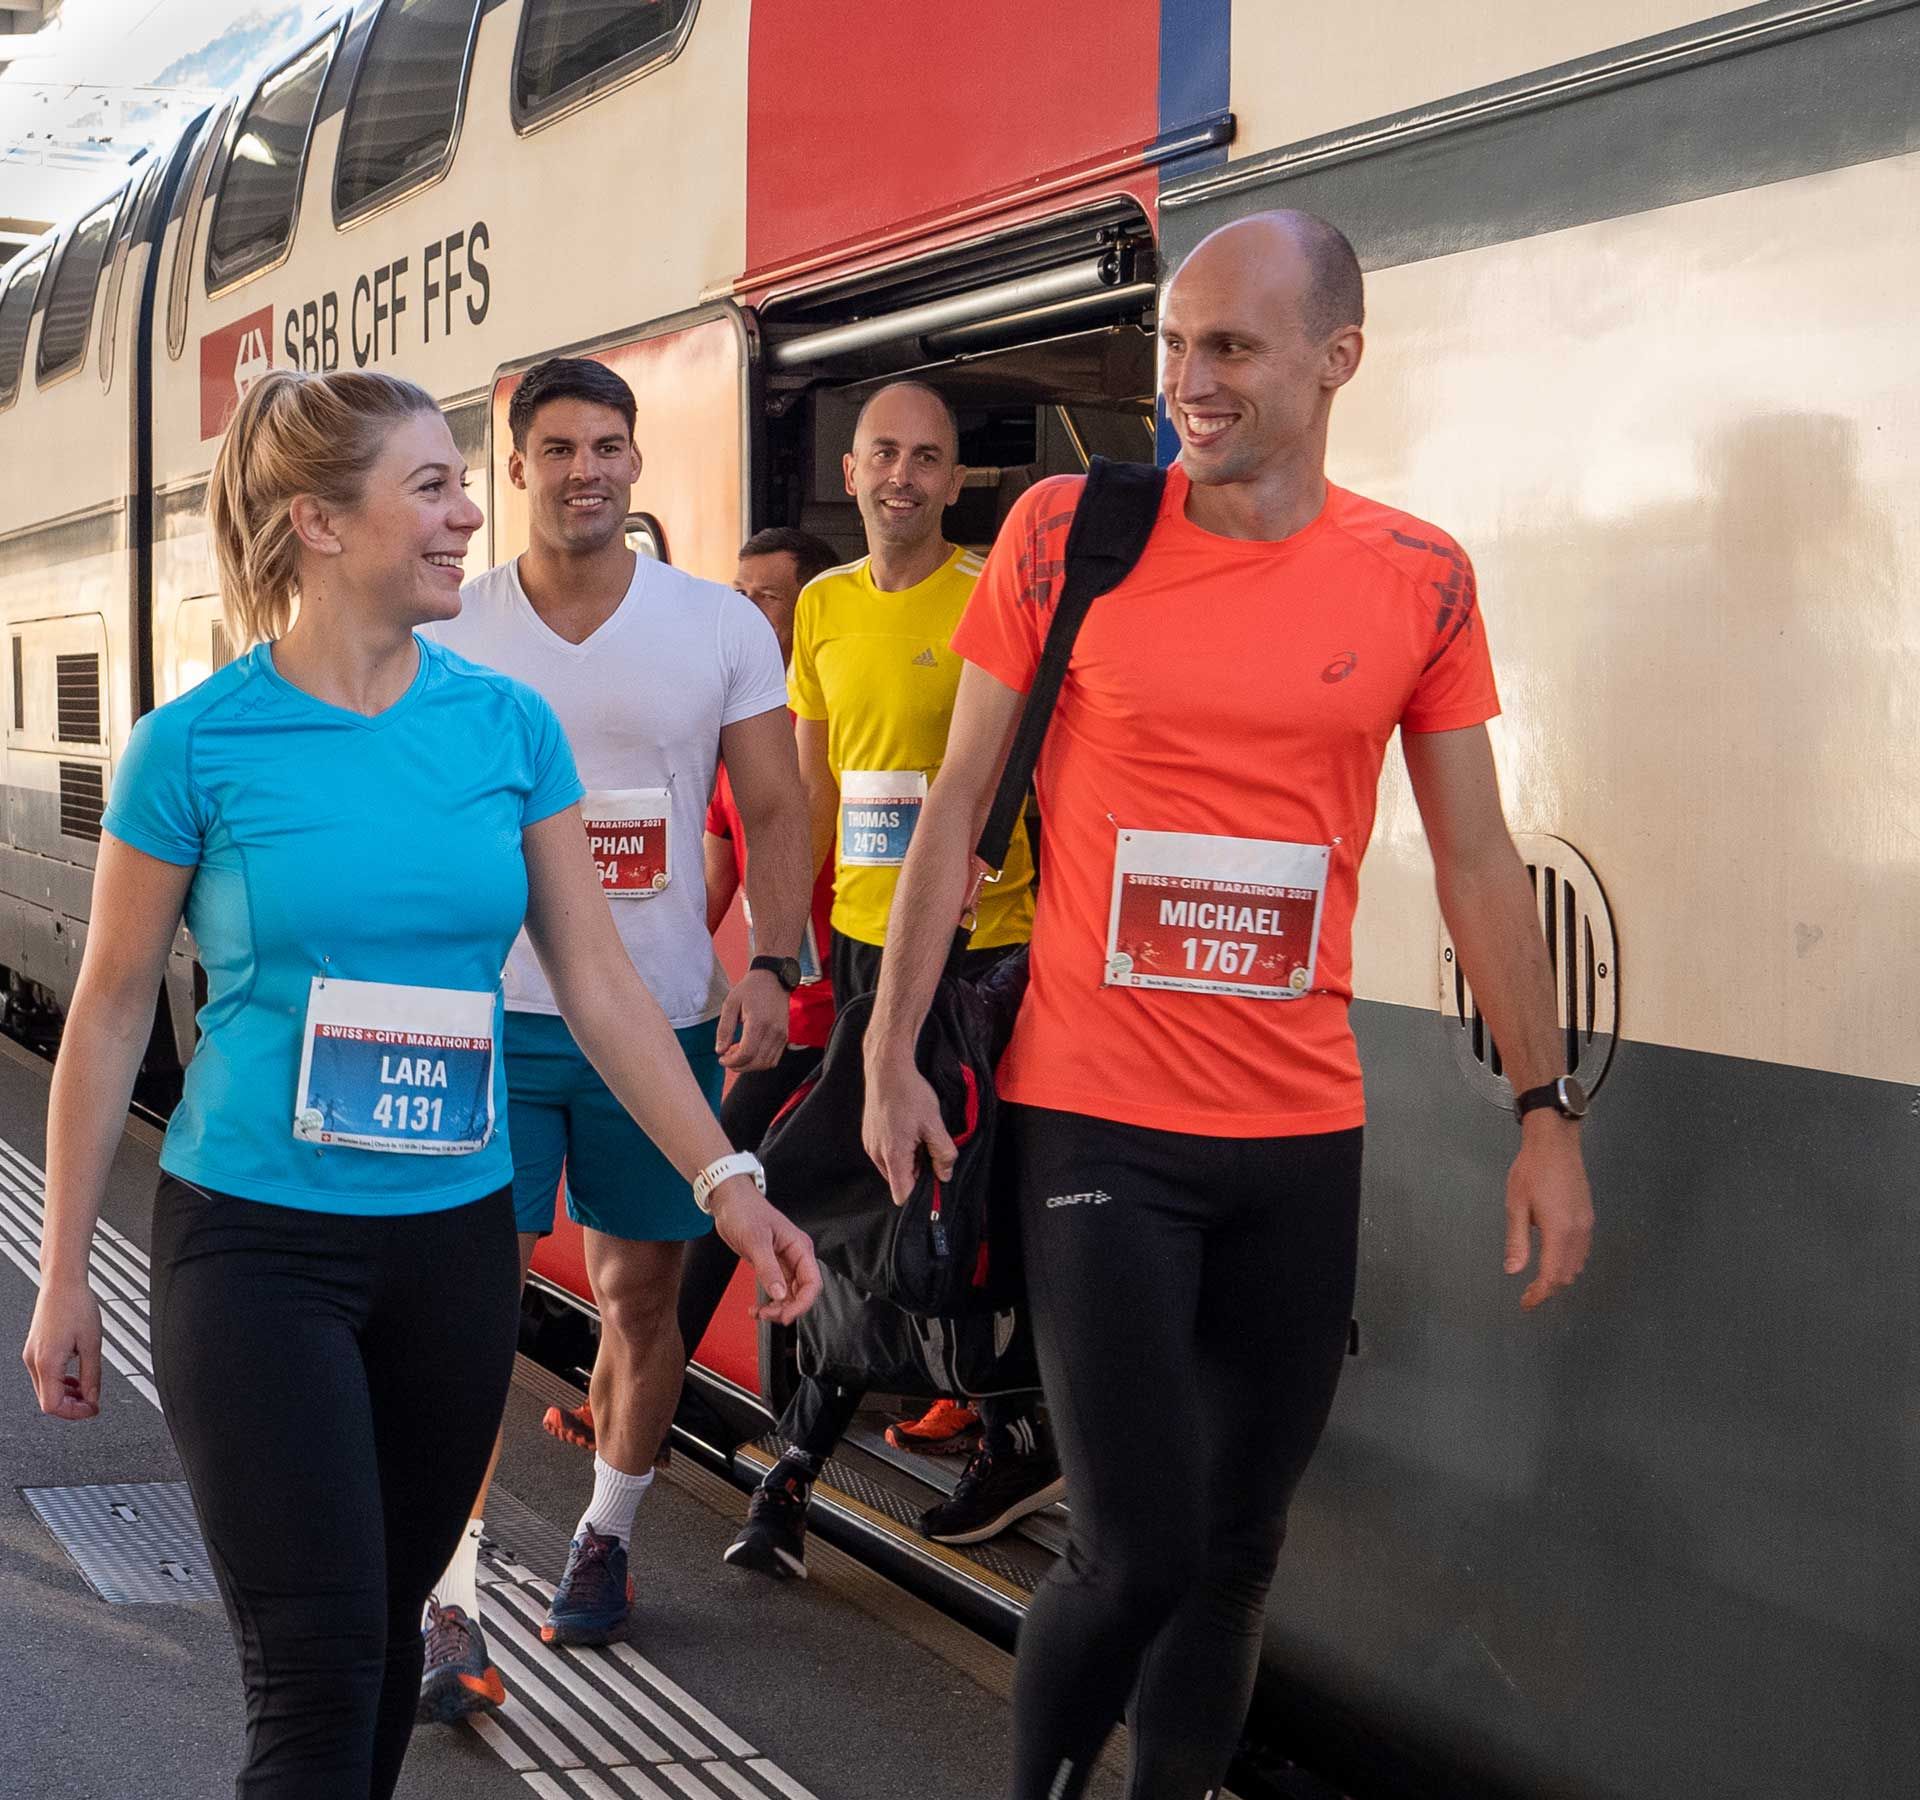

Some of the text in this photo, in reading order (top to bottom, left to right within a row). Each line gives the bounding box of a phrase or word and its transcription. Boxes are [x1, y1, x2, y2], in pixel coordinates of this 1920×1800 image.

[285, 221, 490, 374] SBB CFF FFS
[591, 821, 641, 829] MARATHON
[643, 820, 662, 828] 2021
[848, 812, 900, 828] THOMAS
[587, 836, 644, 855] PHAN
[854, 832, 888, 853] 2479
[1128, 876, 1312, 900] SWISS CITY MARATHON 2021
[1158, 899, 1284, 936] MICHAEL
[1182, 938, 1258, 976] 1767
[322, 1025, 363, 1040] SWISS
[375, 1031, 404, 1044] CITY
[407, 1034, 471, 1049] MARATHON
[380, 1056, 447, 1088] LARA
[373, 1094, 443, 1132] 4131
